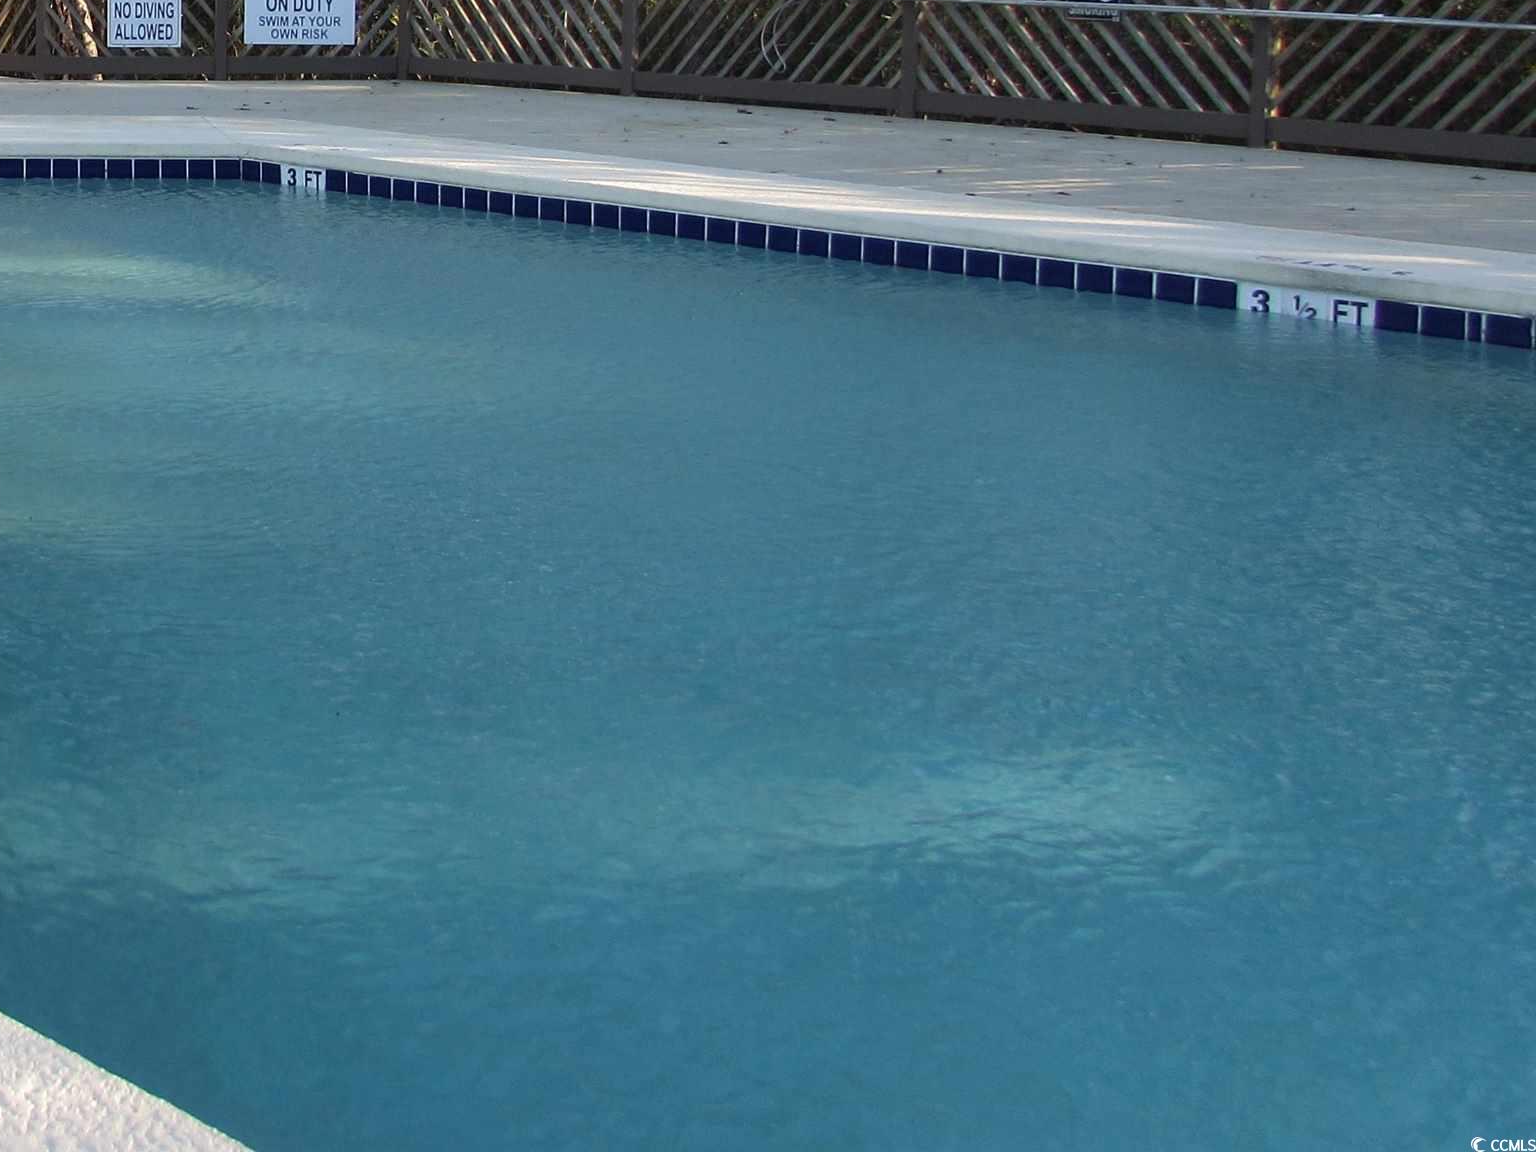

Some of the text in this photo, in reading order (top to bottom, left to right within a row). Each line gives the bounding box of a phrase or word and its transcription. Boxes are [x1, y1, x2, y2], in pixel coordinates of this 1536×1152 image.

[114, 2, 174, 19] NO DIVING
[258, 15, 341, 27] SWIM AT YOUR
[114, 23, 174, 40] ALLOWED
[270, 28, 328, 40] OWN RISK
[287, 168, 322, 191] 3 FT
[1251, 289, 1270, 312] 3
[1333, 299, 1369, 326] FT
